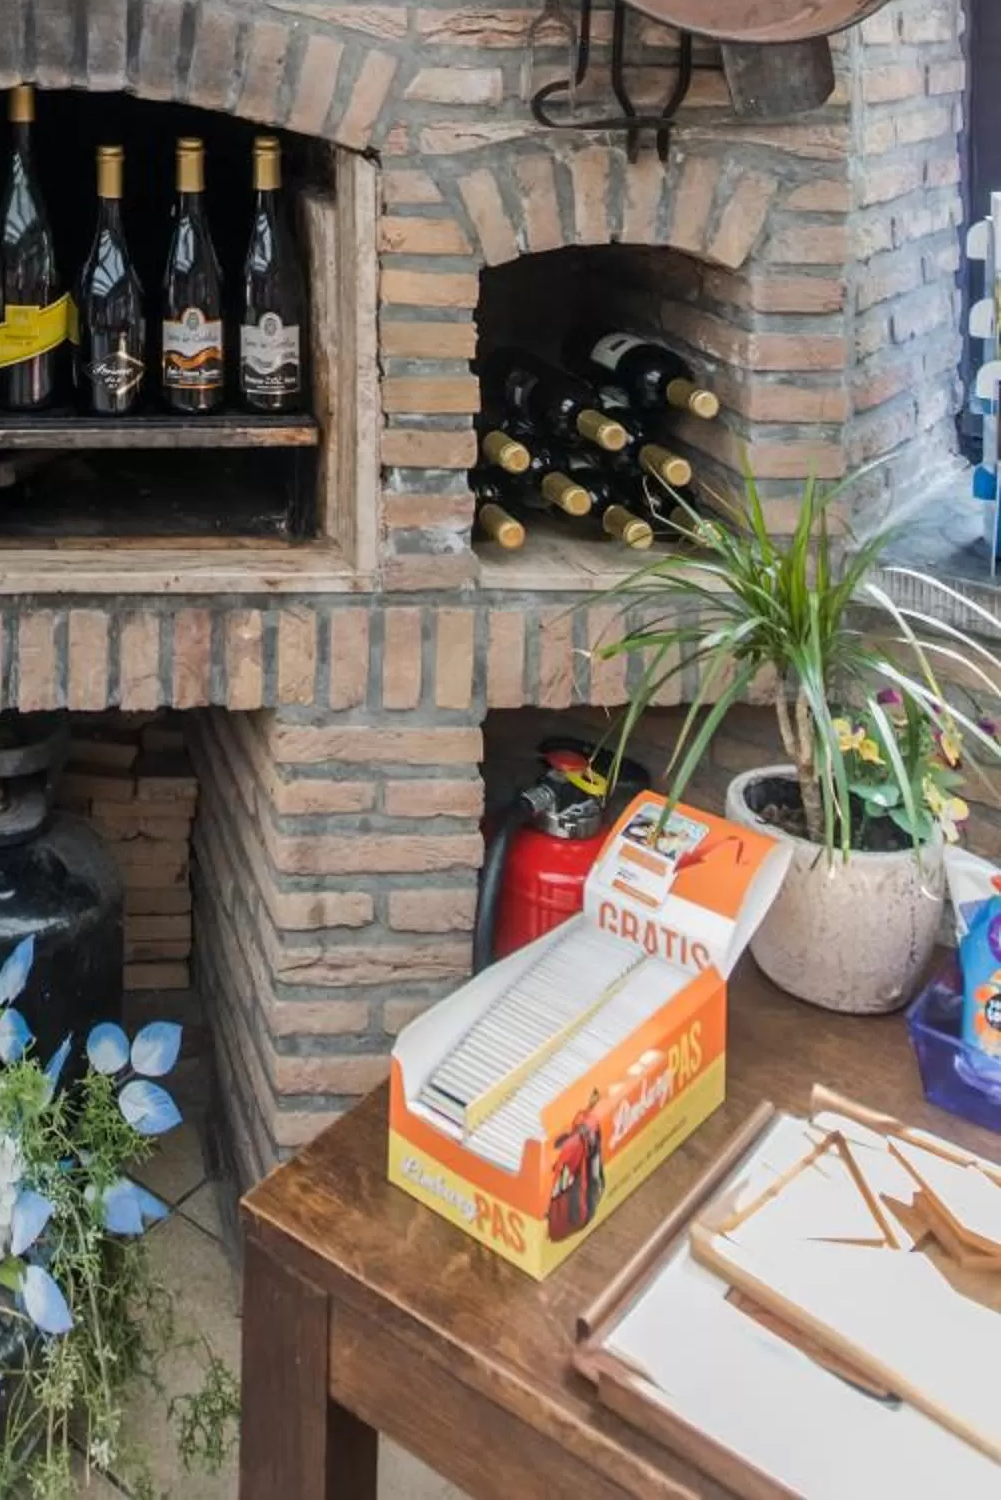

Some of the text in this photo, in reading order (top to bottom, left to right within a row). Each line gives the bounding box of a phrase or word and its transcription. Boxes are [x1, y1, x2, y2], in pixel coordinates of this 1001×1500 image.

[598, 899, 710, 971] GRATIS
[668, 1020, 703, 1088] PAS
[474, 1191, 527, 1253] PAS
